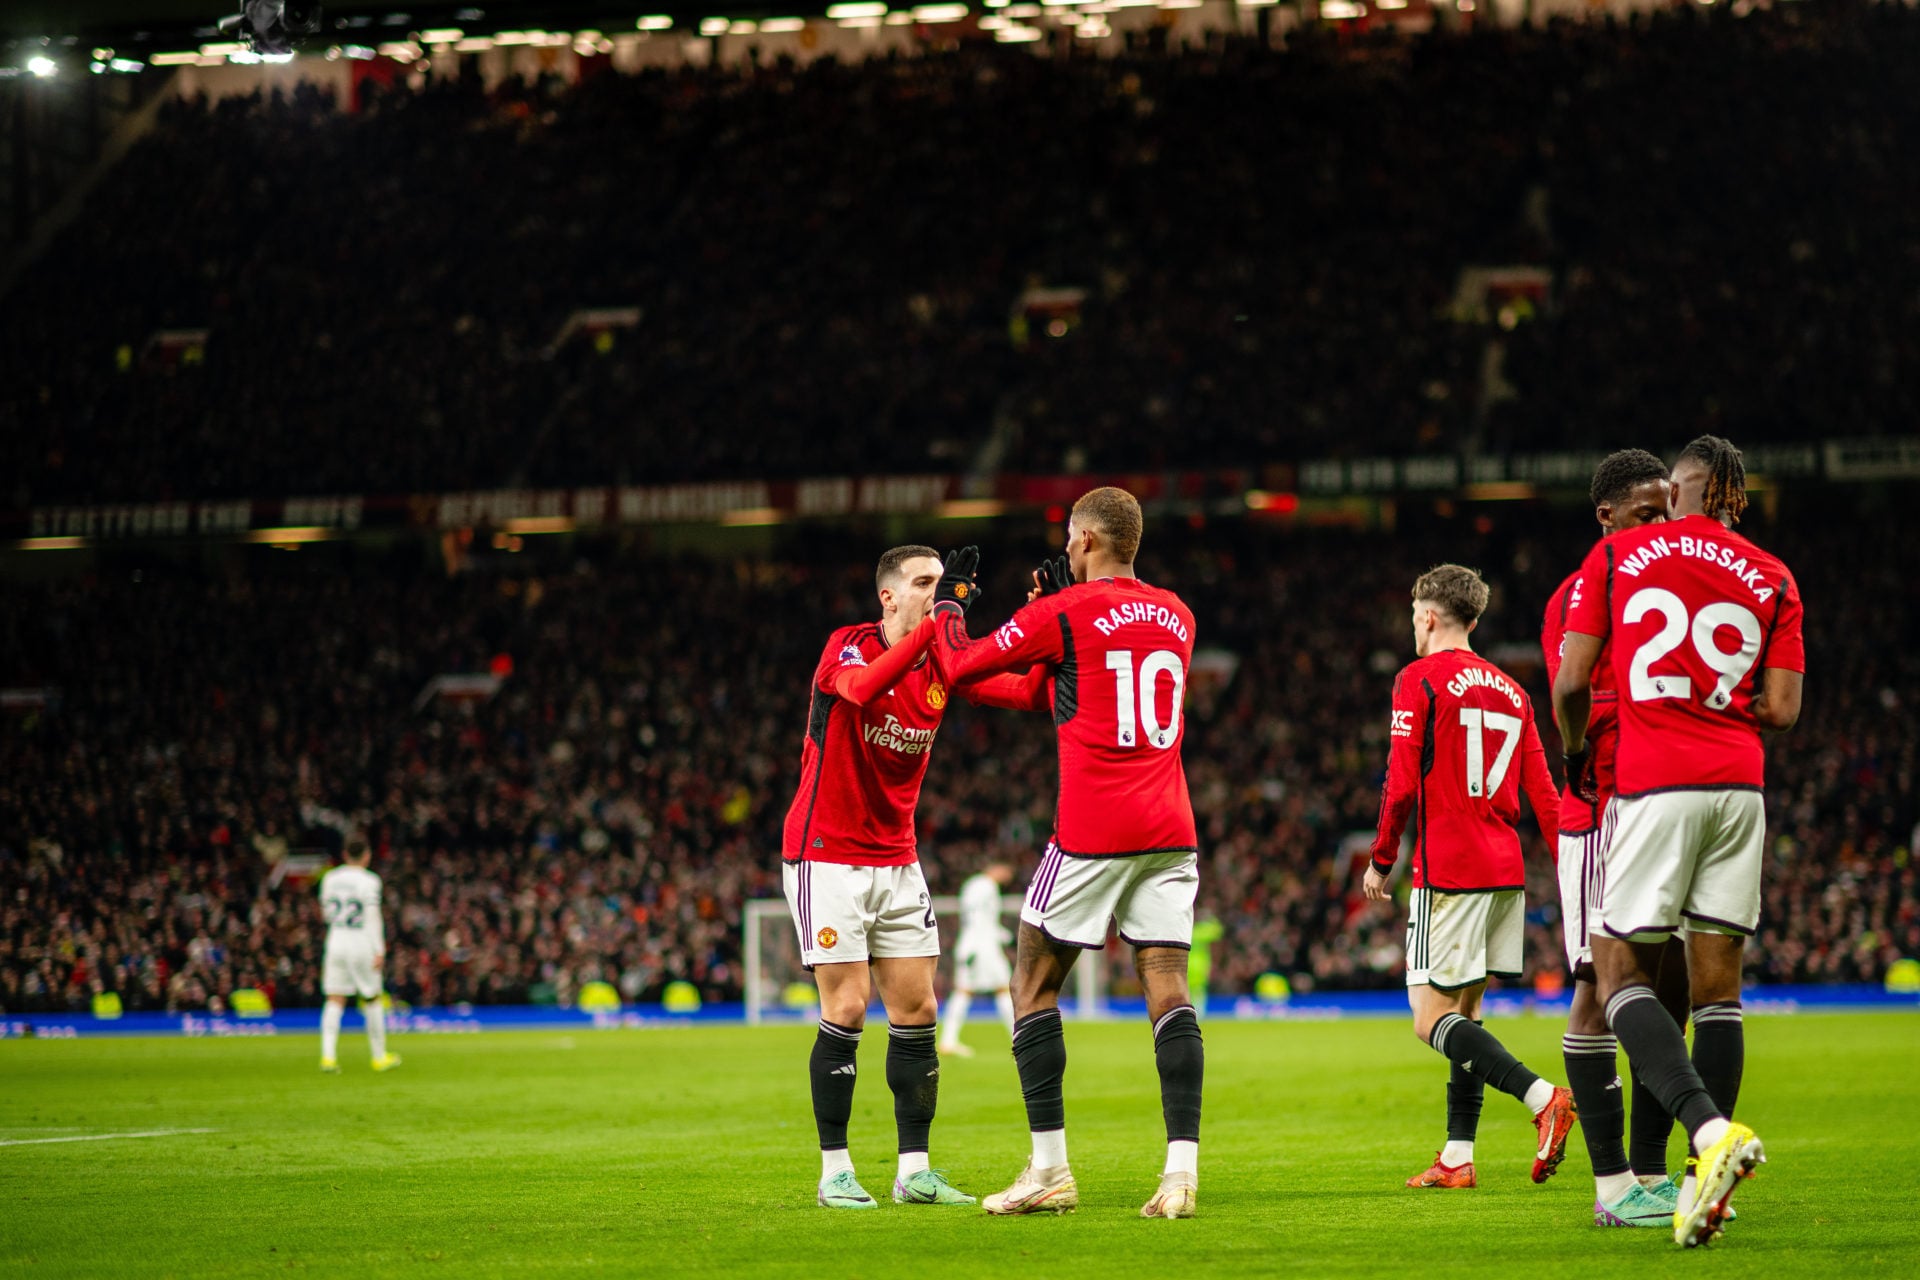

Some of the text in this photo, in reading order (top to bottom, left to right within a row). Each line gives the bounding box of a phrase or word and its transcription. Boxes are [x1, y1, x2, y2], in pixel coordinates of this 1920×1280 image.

[1618, 536, 1774, 604] WAN-BISSAKA
[1093, 602, 1188, 643] RASHFORD
[1623, 587, 1762, 710] 29
[1106, 650, 1184, 749] 10
[1446, 667, 1523, 709] GARNACHO
[864, 723, 928, 755] Viewer
[884, 713, 932, 742] Team
[1459, 707, 1523, 800] 17
[328, 898, 364, 929] 22
